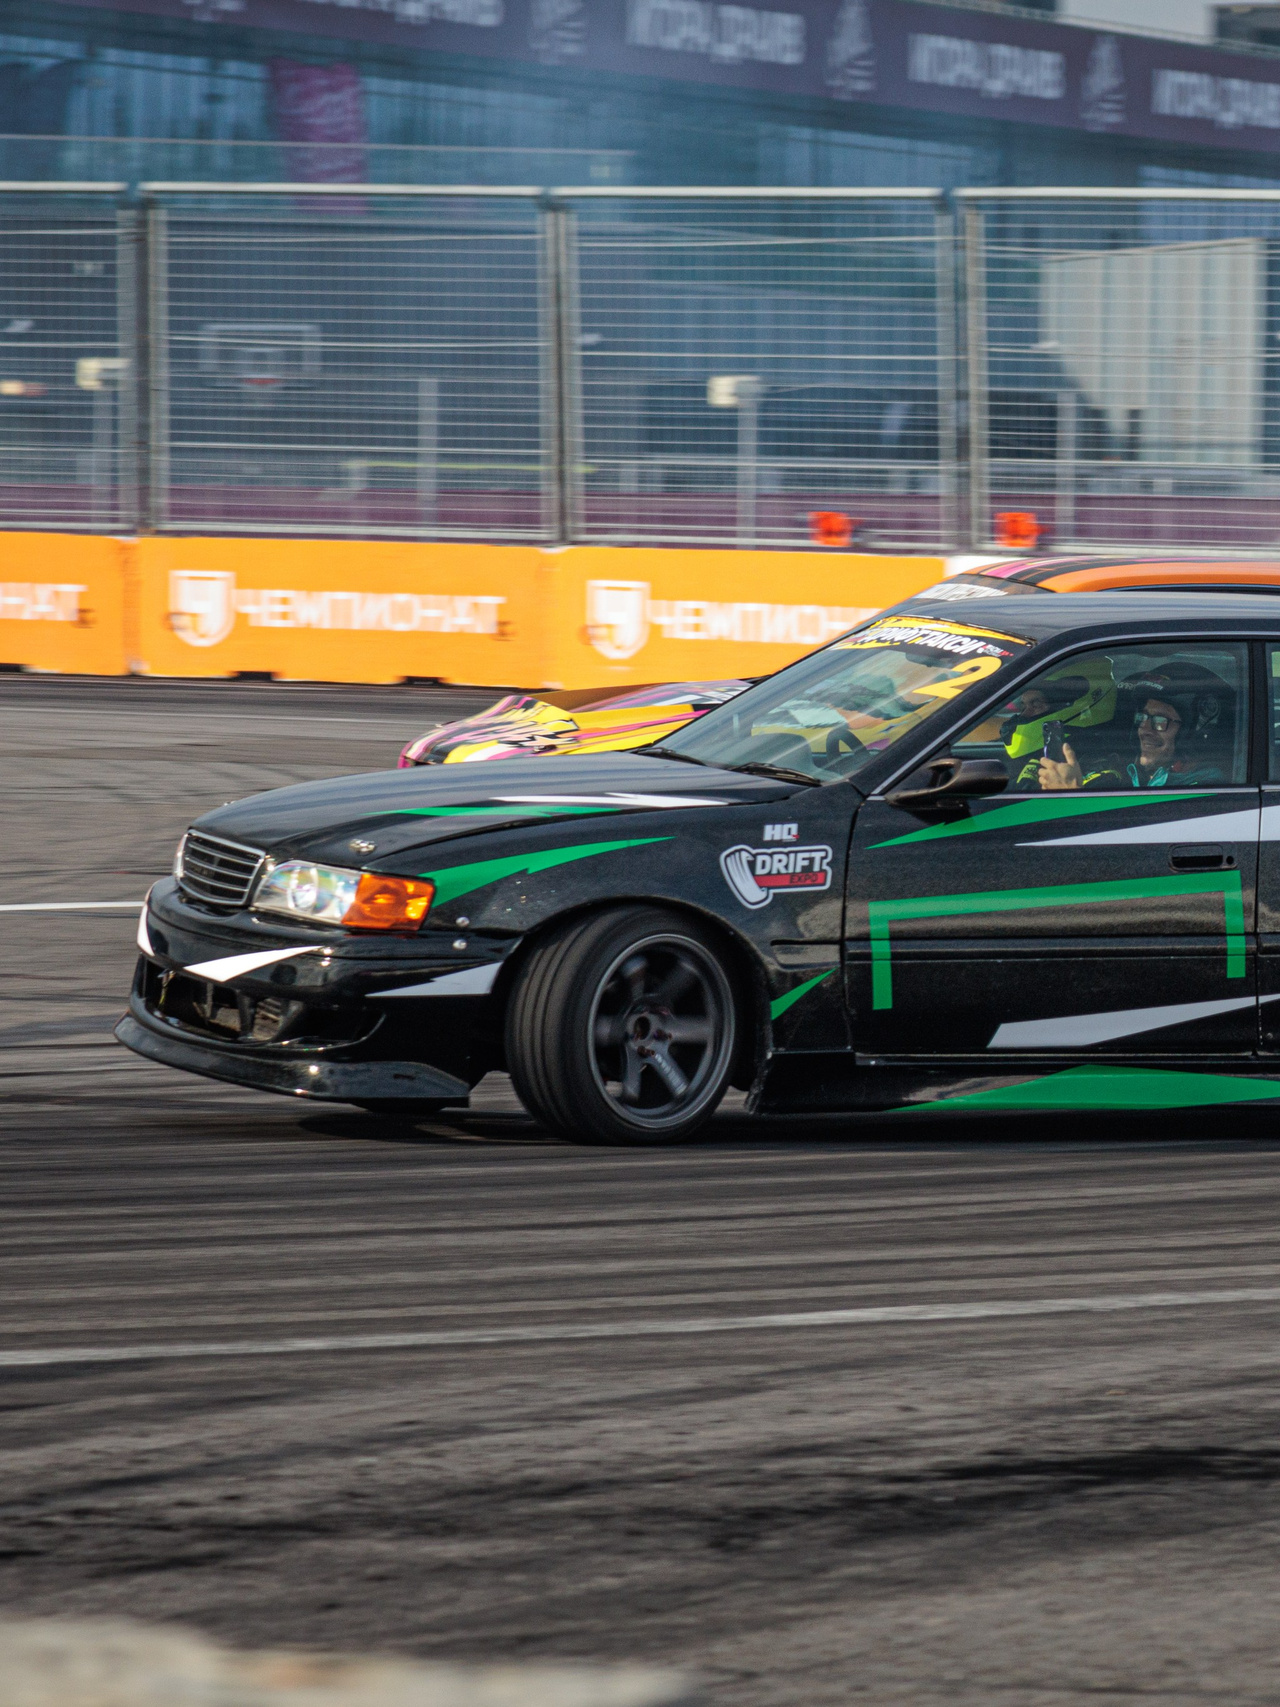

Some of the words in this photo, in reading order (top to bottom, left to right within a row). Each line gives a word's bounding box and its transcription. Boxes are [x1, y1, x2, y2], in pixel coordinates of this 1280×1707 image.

[233, 588, 506, 634] ЧЕМПИОНАТ
[650, 599, 886, 645] ЧЕМПИОН
[912, 656, 1002, 699] 2
[763, 823, 799, 842] HQ
[754, 851, 827, 875] DRIFT
[789, 873, 818, 884] EXPO
